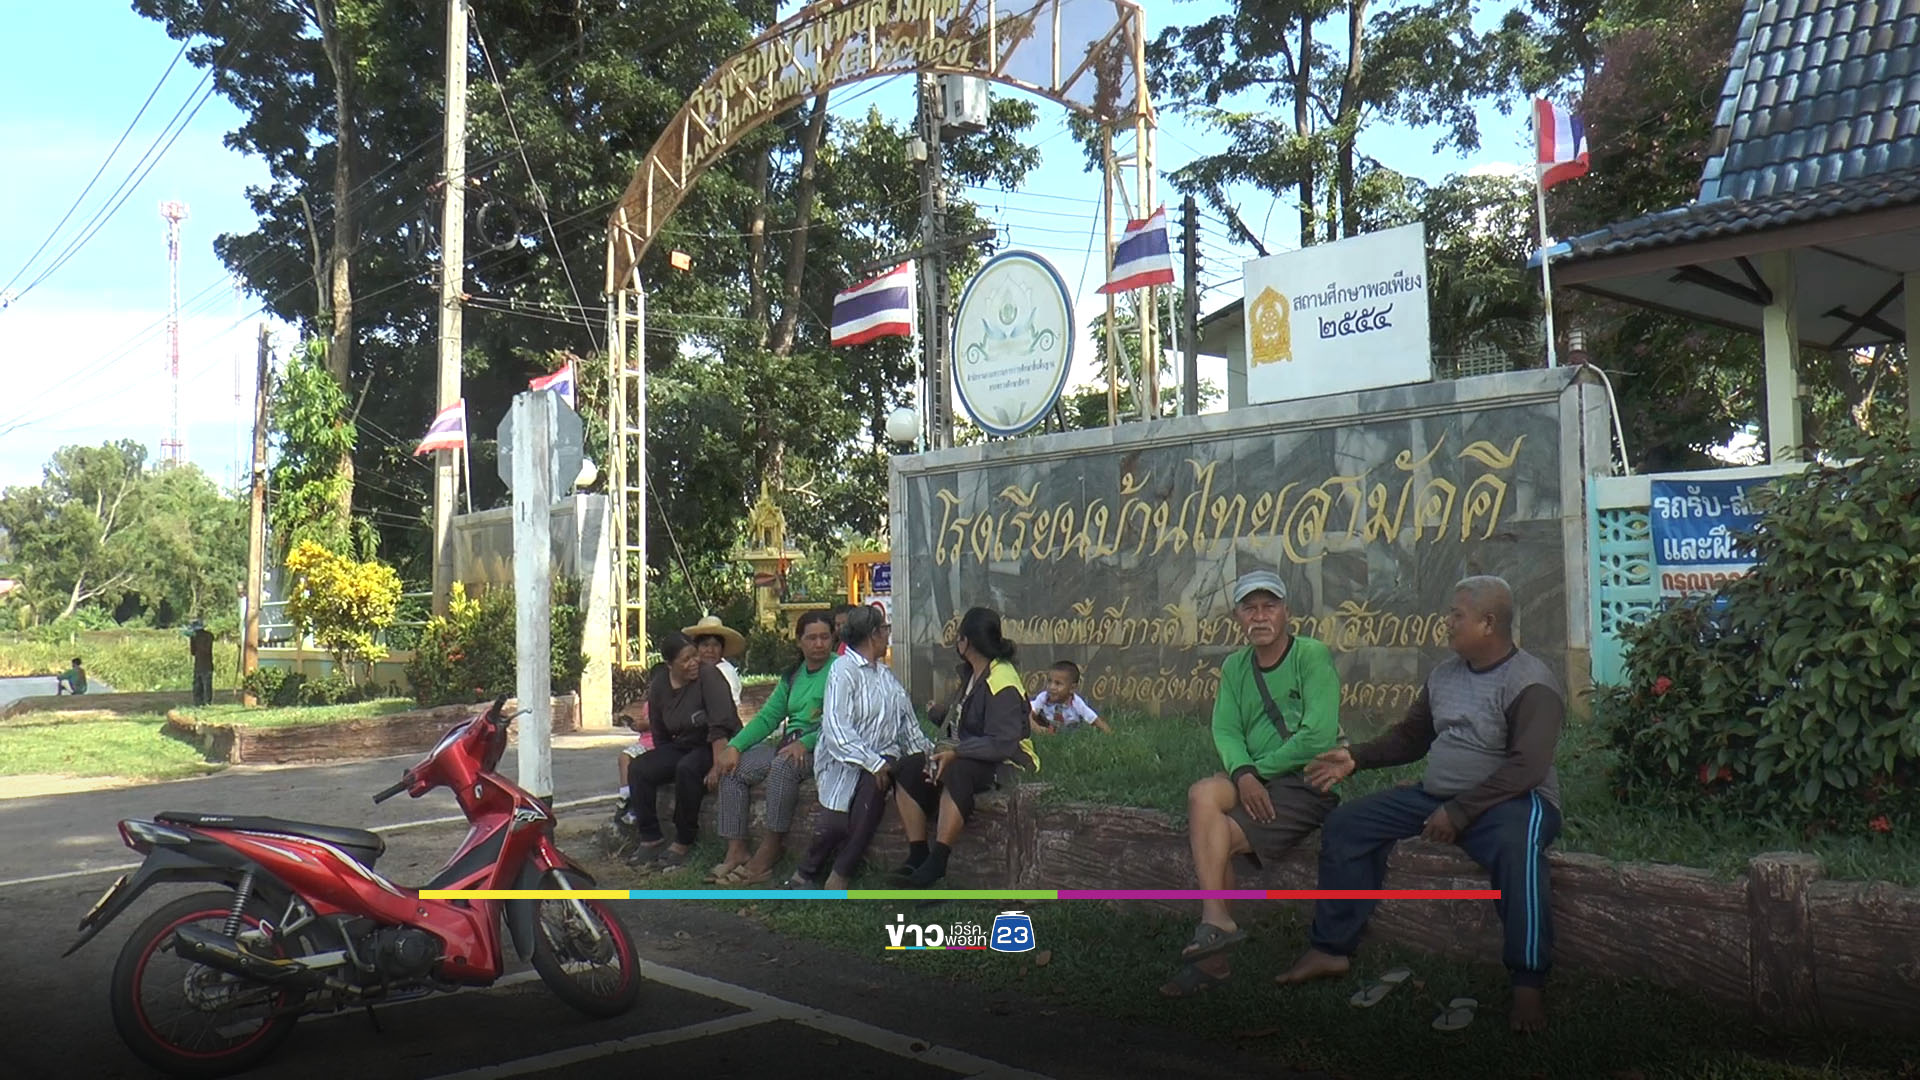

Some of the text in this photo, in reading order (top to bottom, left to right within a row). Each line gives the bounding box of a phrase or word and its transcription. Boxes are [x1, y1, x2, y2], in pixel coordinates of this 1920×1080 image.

[684, 131, 717, 176] BAN
[880, 36, 974, 67] SCHOOL
[1292, 270, 1422, 311] สถานศึกษาพอเพียง
[1318, 303, 1393, 339] ๒๕๕๔
[934, 431, 1527, 566] โรงเรียนบ้านไทยสามัคคี
